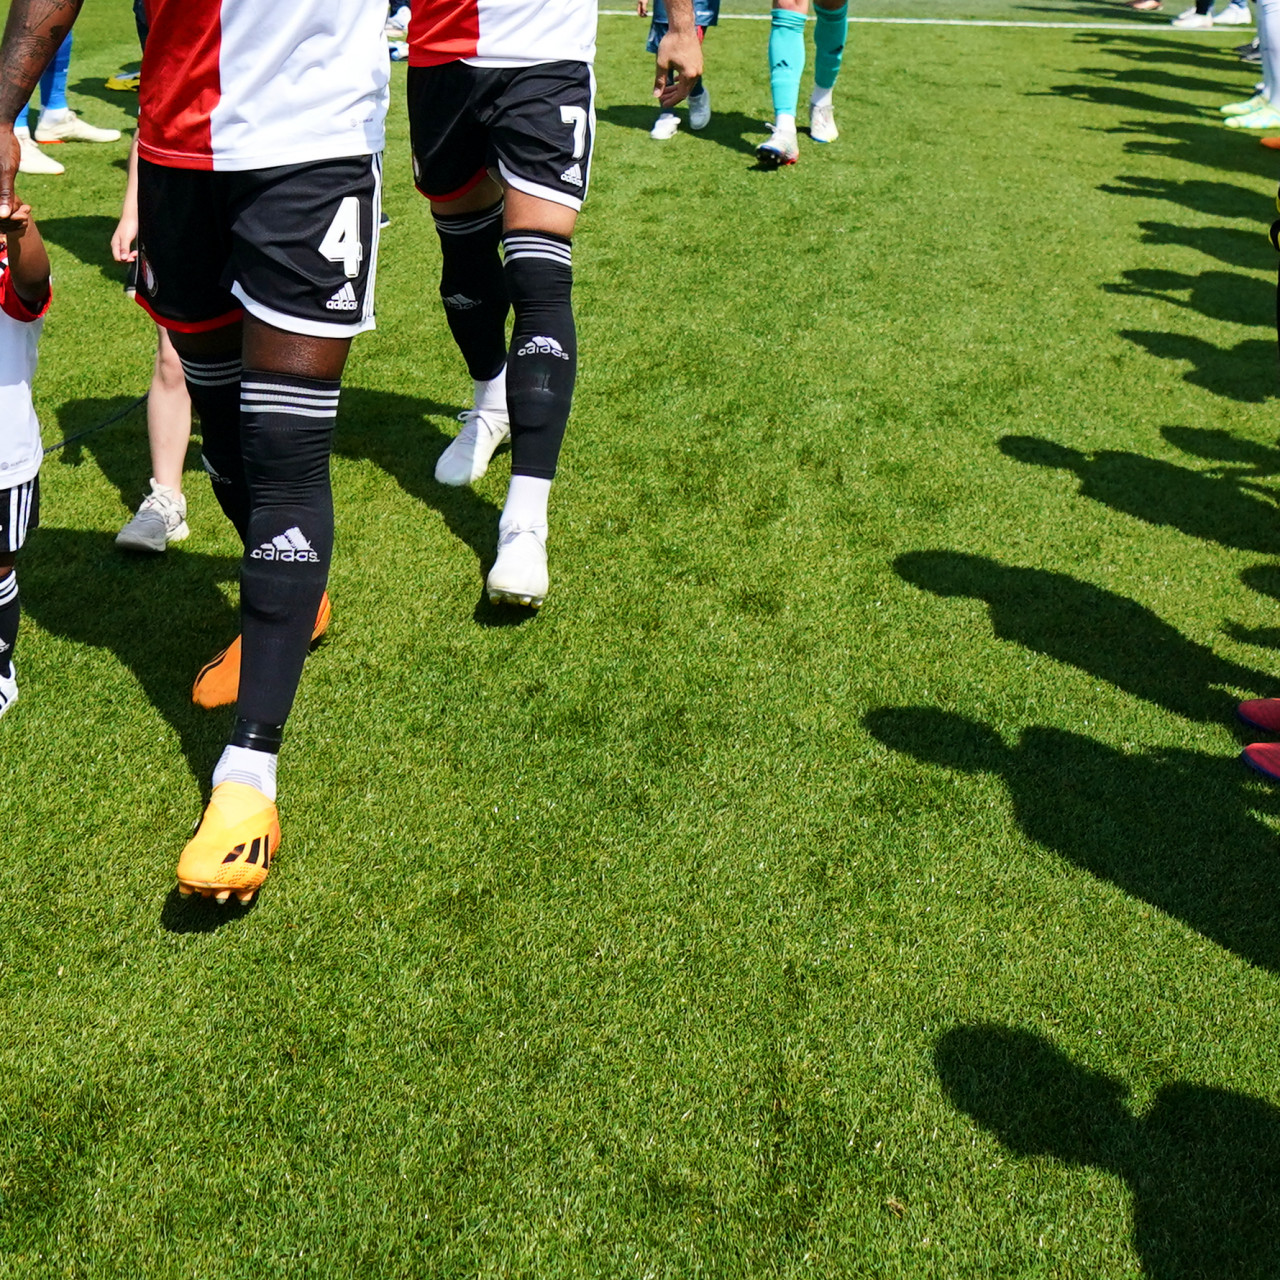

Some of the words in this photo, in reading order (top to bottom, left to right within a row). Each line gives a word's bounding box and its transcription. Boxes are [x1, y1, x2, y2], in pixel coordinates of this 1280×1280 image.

[559, 105, 588, 160] 7
[319, 197, 363, 278] 4
[326, 299, 359, 311] adidas
[516, 342, 570, 361] adidas
[250, 546, 321, 563] adidas
